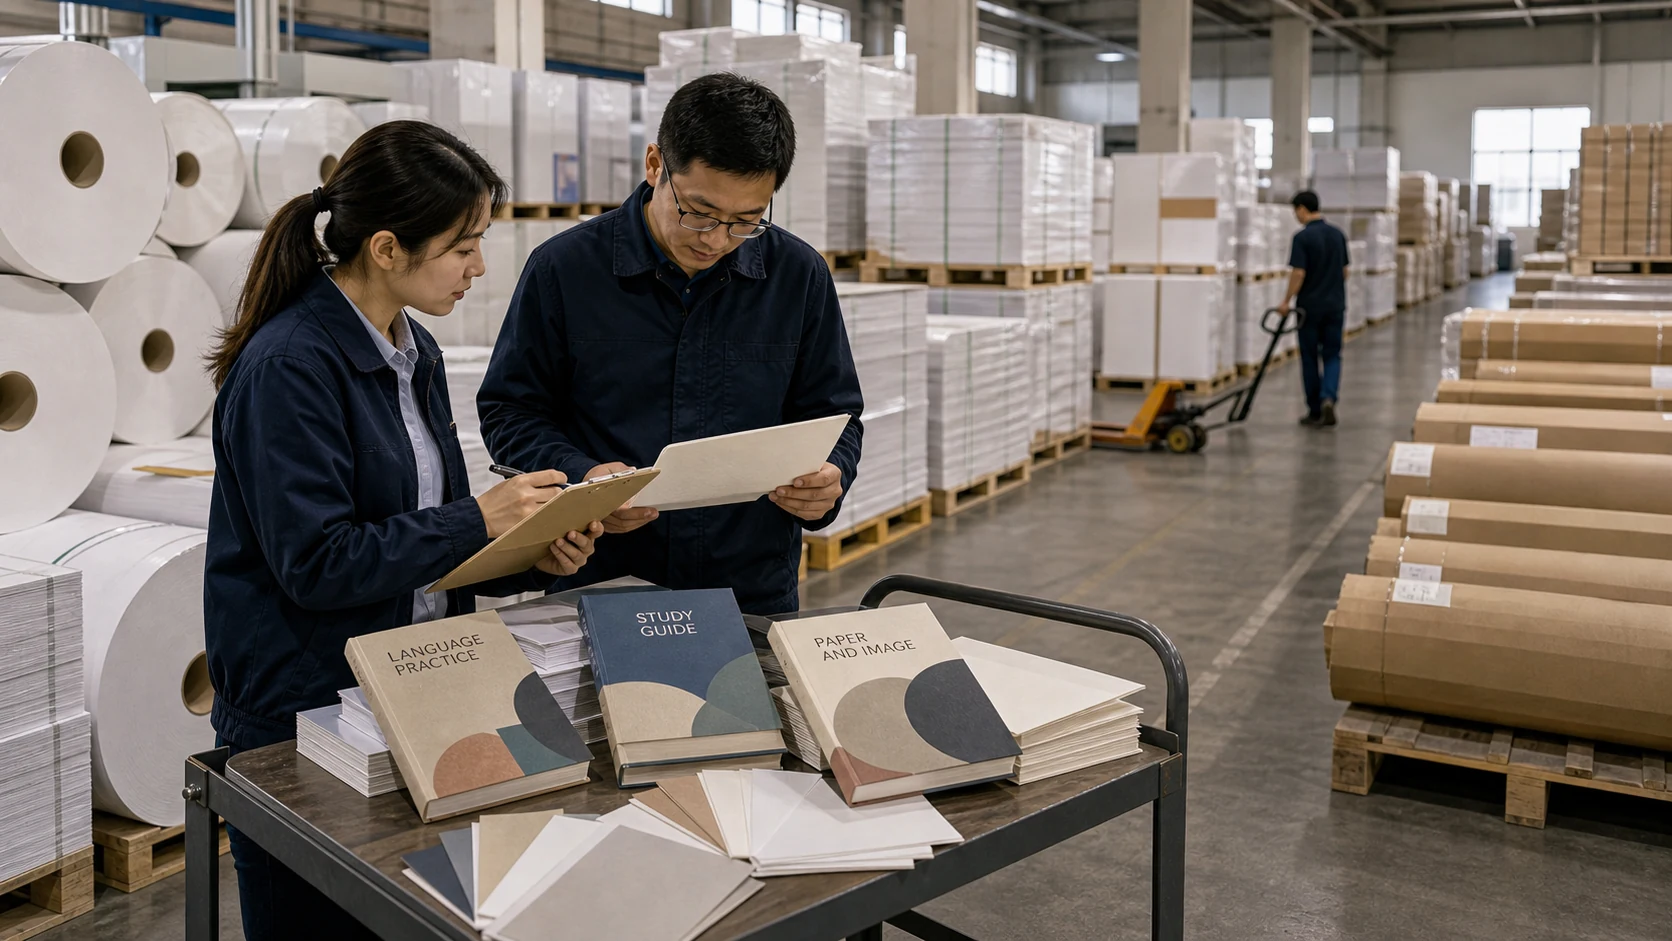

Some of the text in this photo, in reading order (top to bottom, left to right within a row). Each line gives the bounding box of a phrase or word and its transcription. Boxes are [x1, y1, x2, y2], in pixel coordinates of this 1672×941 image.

[636, 610, 693, 624] STUDY
[640, 623, 698, 637] GUIDE
[387, 634, 485, 663] LANGUAGE
[814, 632, 868, 648] PAPER
[823, 639, 917, 662] AND IMAGE
[394, 649, 480, 676] PRACTICE
